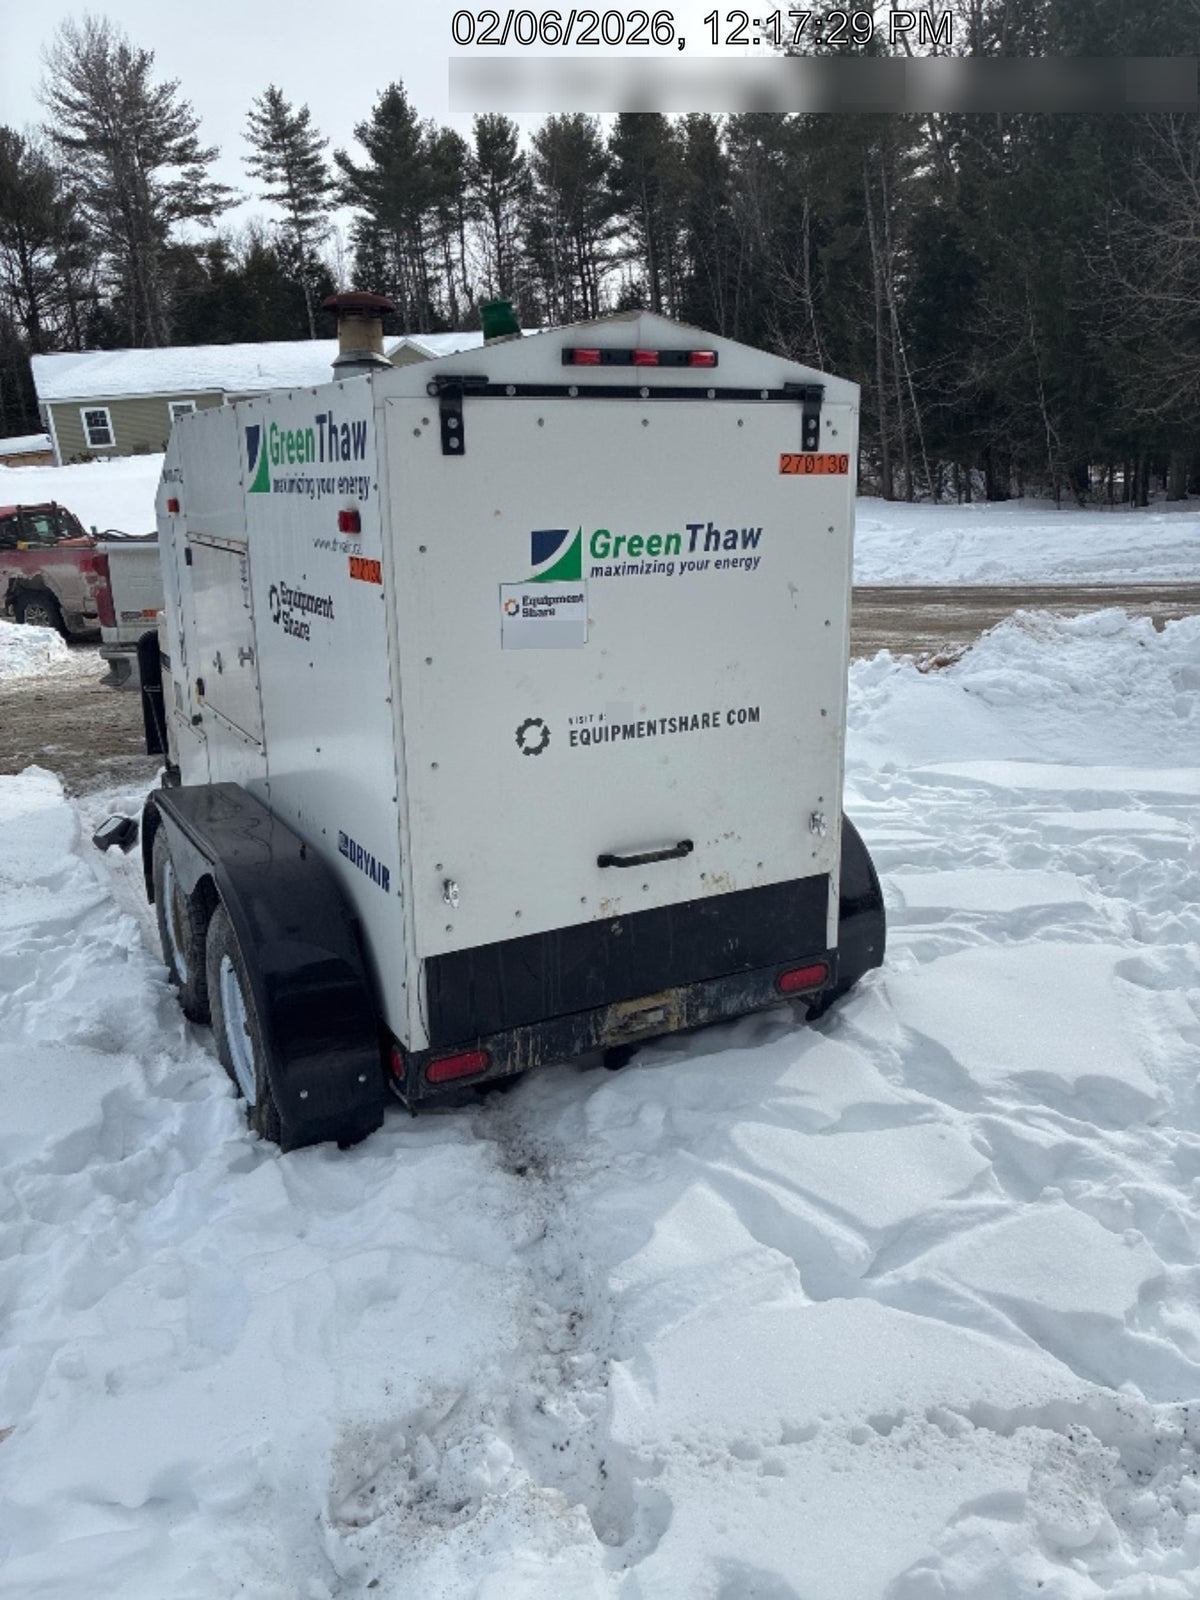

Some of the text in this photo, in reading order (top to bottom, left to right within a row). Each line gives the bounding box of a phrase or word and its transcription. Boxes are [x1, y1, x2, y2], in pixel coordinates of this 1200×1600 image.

[781, 454, 849, 474] 270130
[589, 522, 763, 559] GreenThaw
[590, 556, 762, 578] maximizing your energy
[349, 838, 390, 894] DRYAIR
